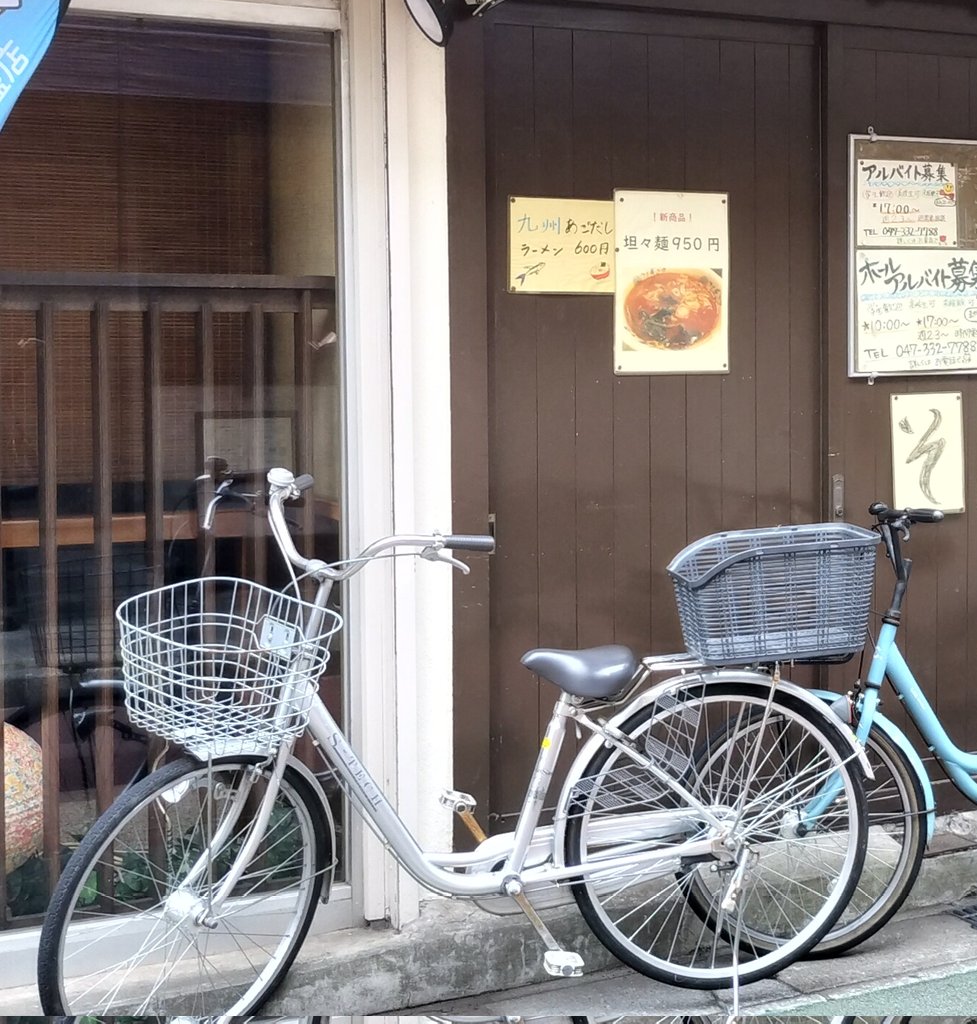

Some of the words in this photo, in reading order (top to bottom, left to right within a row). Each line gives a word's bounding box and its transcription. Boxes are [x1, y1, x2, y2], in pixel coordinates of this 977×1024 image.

[862, 164, 949, 182] アルバイト募集
[521, 244, 564, 257] ラーメン
[574, 240, 609, 255] 600円
[859, 257, 901, 286] ホール
[864, 347, 889, 359] TEL
[895, 340, 977, 358] 047-332-7788
